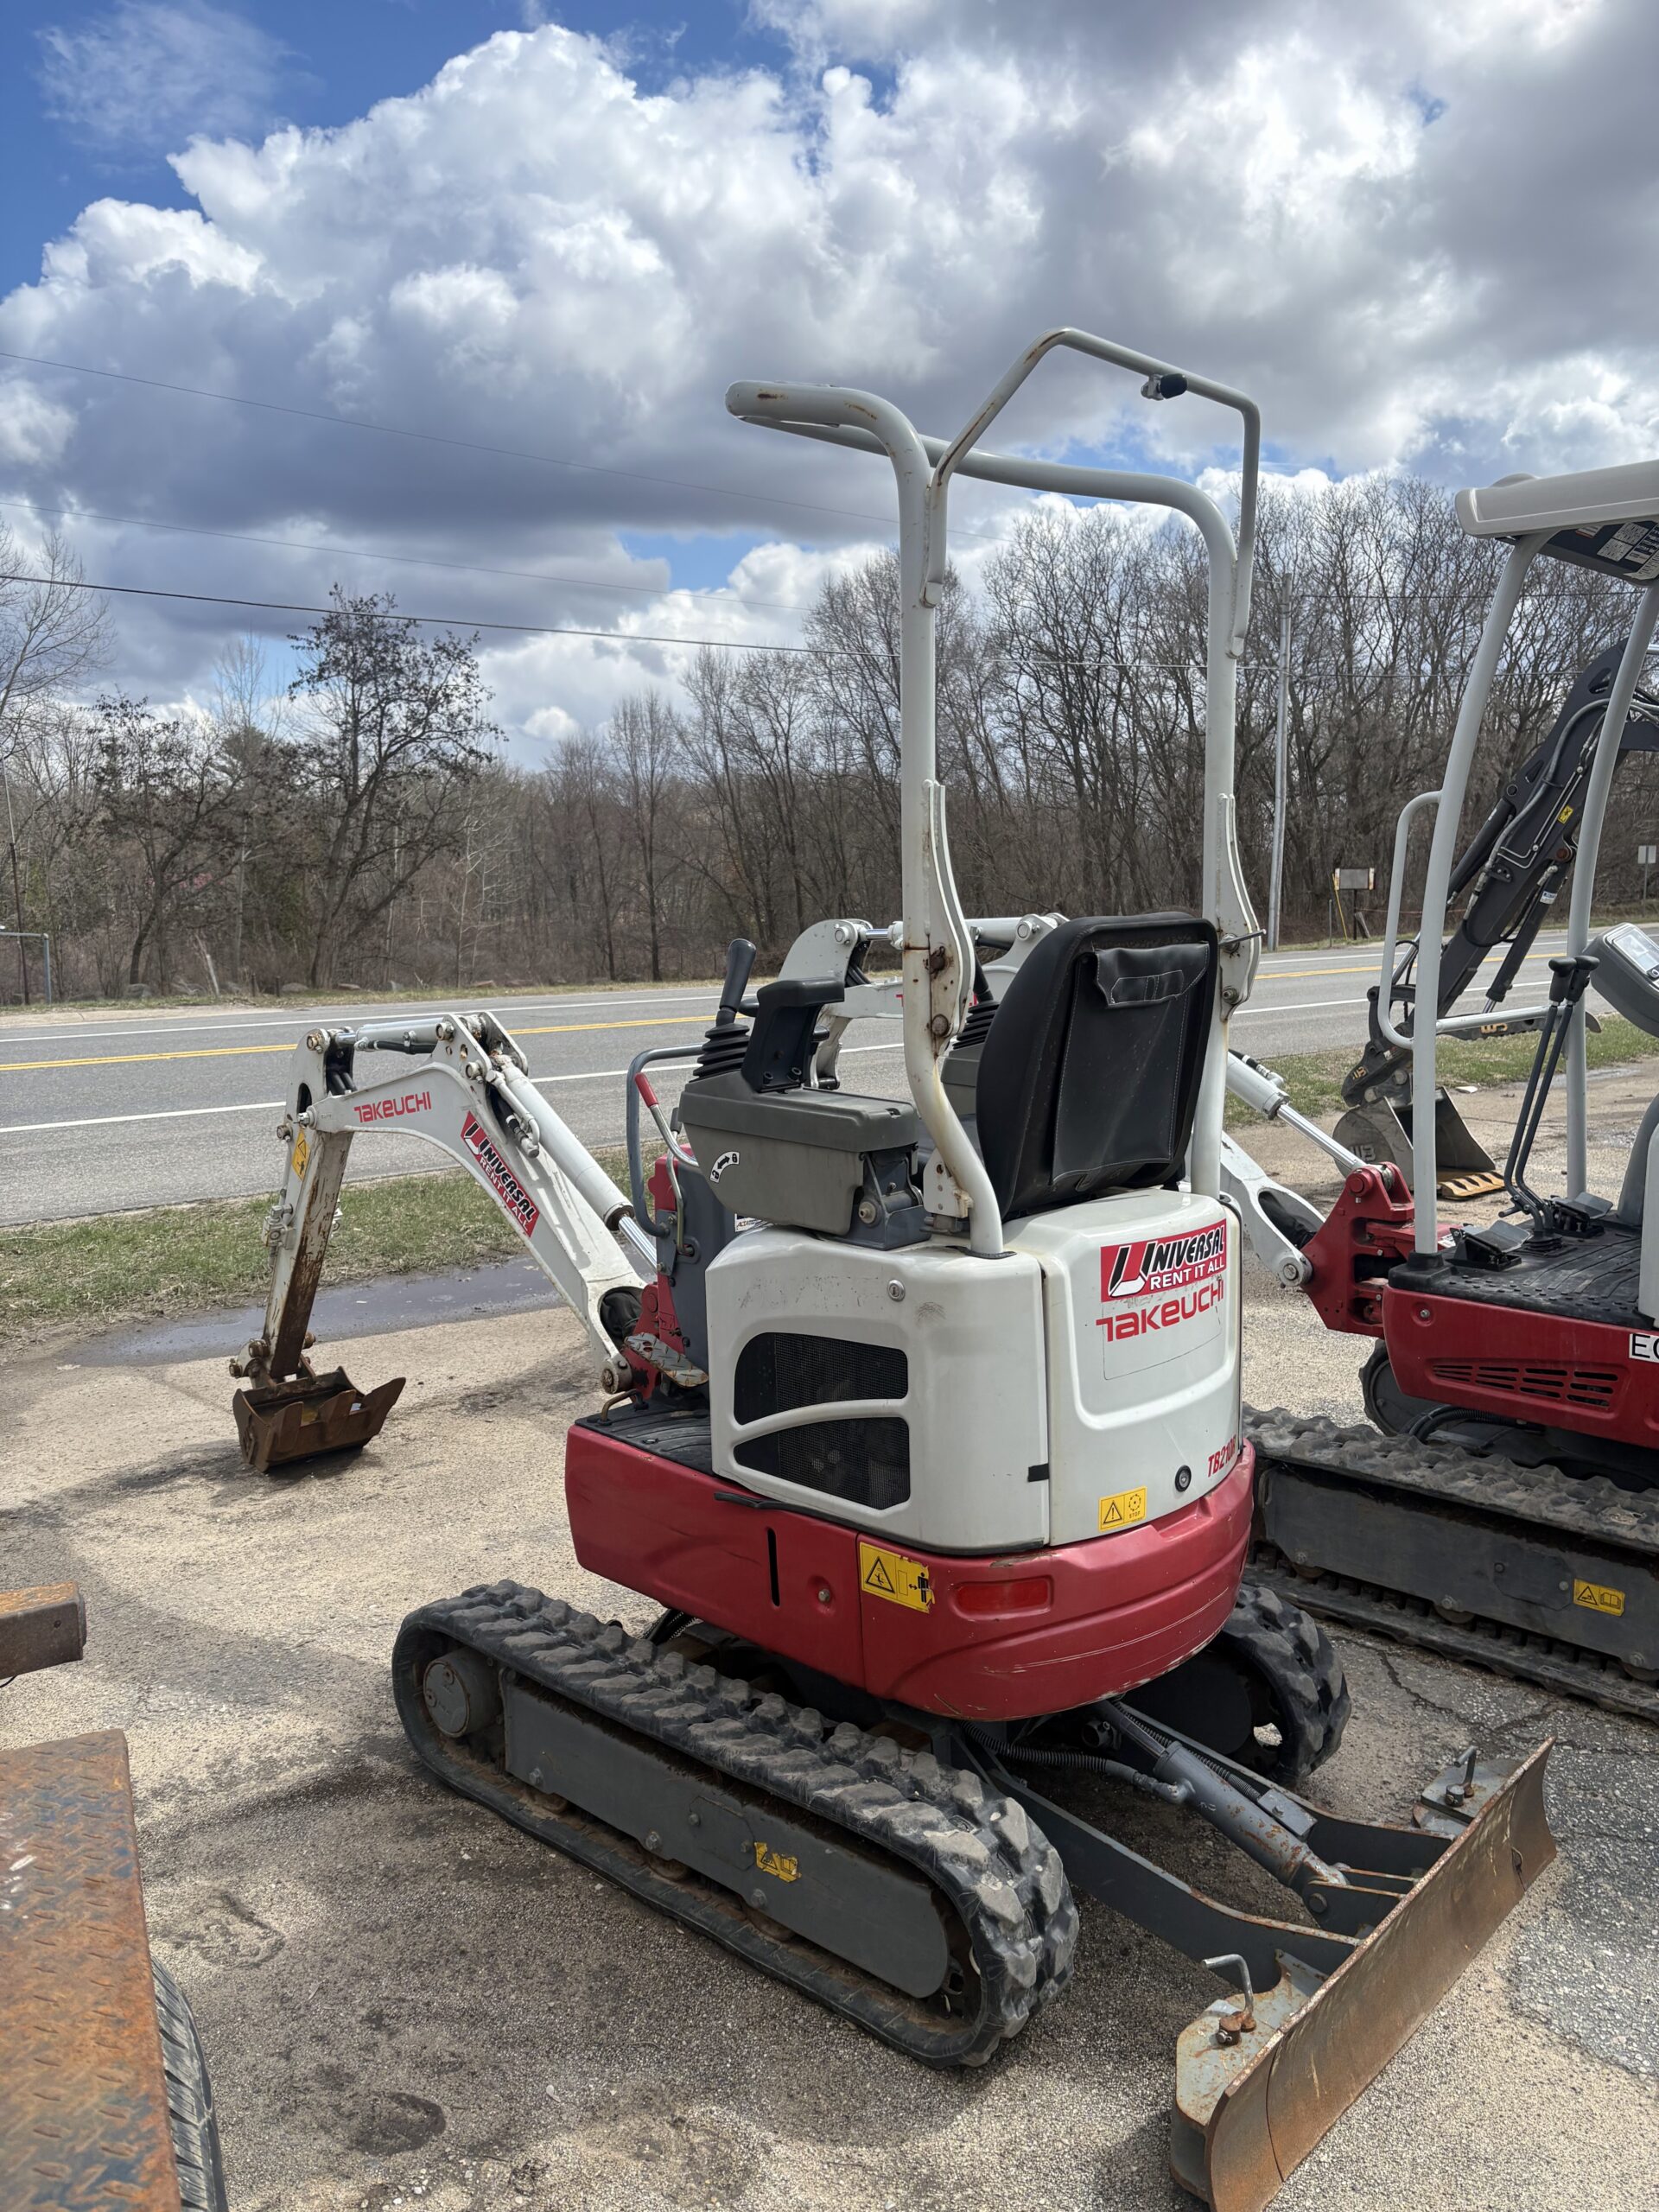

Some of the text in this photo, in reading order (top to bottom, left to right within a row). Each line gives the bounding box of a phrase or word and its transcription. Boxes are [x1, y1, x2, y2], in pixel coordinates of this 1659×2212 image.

[464, 1121, 536, 1223] UNIVERSAL
[480, 1157, 528, 1231] RENT IT ALL
[1108, 1224, 1225, 1298] UNIVERSAL
[1150, 1256, 1224, 1290] RENT IT ALL
[1631, 1333, 1659, 1359] E
